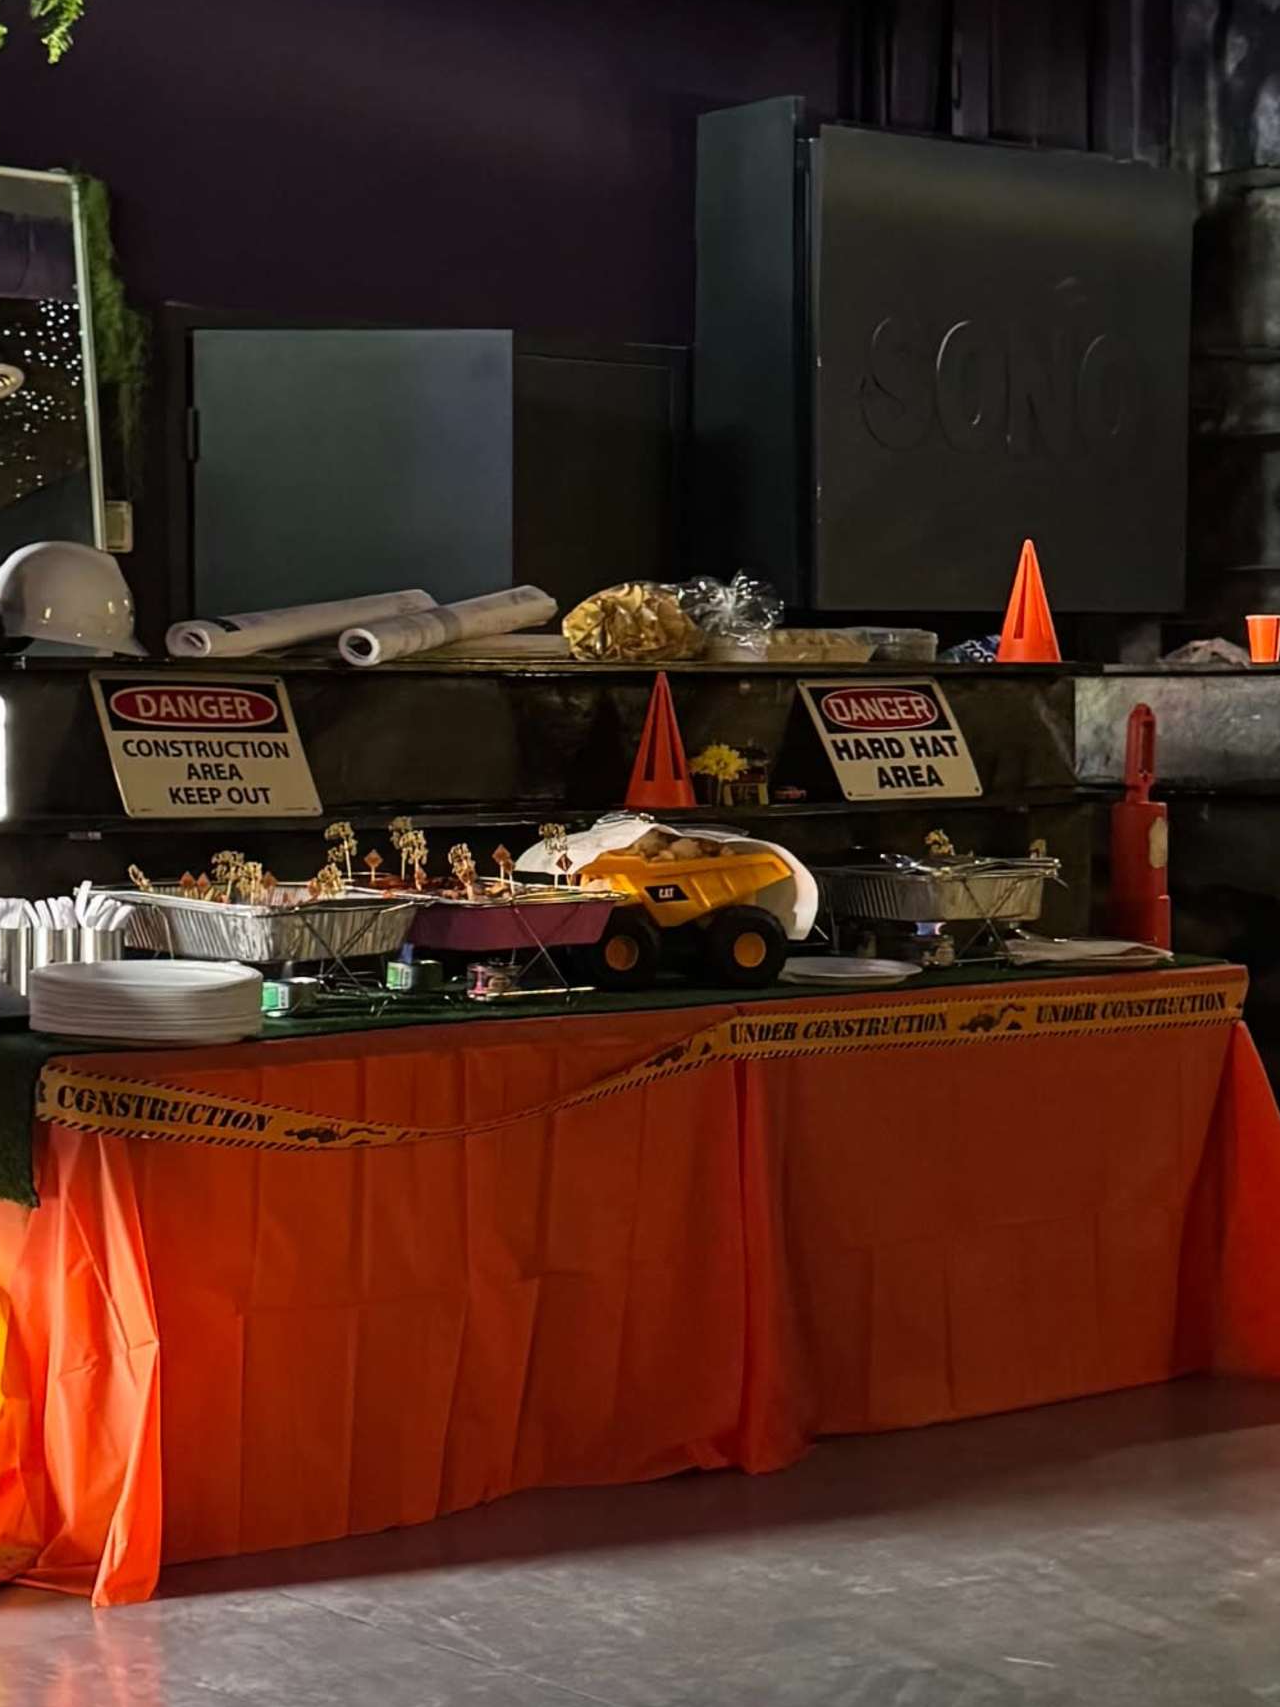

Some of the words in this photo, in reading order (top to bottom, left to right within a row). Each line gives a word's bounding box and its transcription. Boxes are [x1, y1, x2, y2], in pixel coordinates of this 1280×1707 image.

[135, 694, 254, 720] DANGER
[828, 697, 932, 721] DANGER
[122, 739, 290, 758] CONSTRUCTION
[830, 737, 906, 761] HARD
[910, 735, 959, 757] HAT
[187, 763, 243, 780] AREA
[878, 765, 944, 789] AREA
[169, 787, 221, 804] KEEP
[228, 787, 270, 804] OUT
[658, 887, 675, 899] CAT
[1035, 1002, 1097, 1024] UNDER
[1101, 992, 1227, 1020] CONSTRUCTION
[730, 1022, 799, 1044] UNDER
[803, 1013, 948, 1040] CONSTRUCTION
[57, 1085, 273, 1132] CONSTRUCTION
